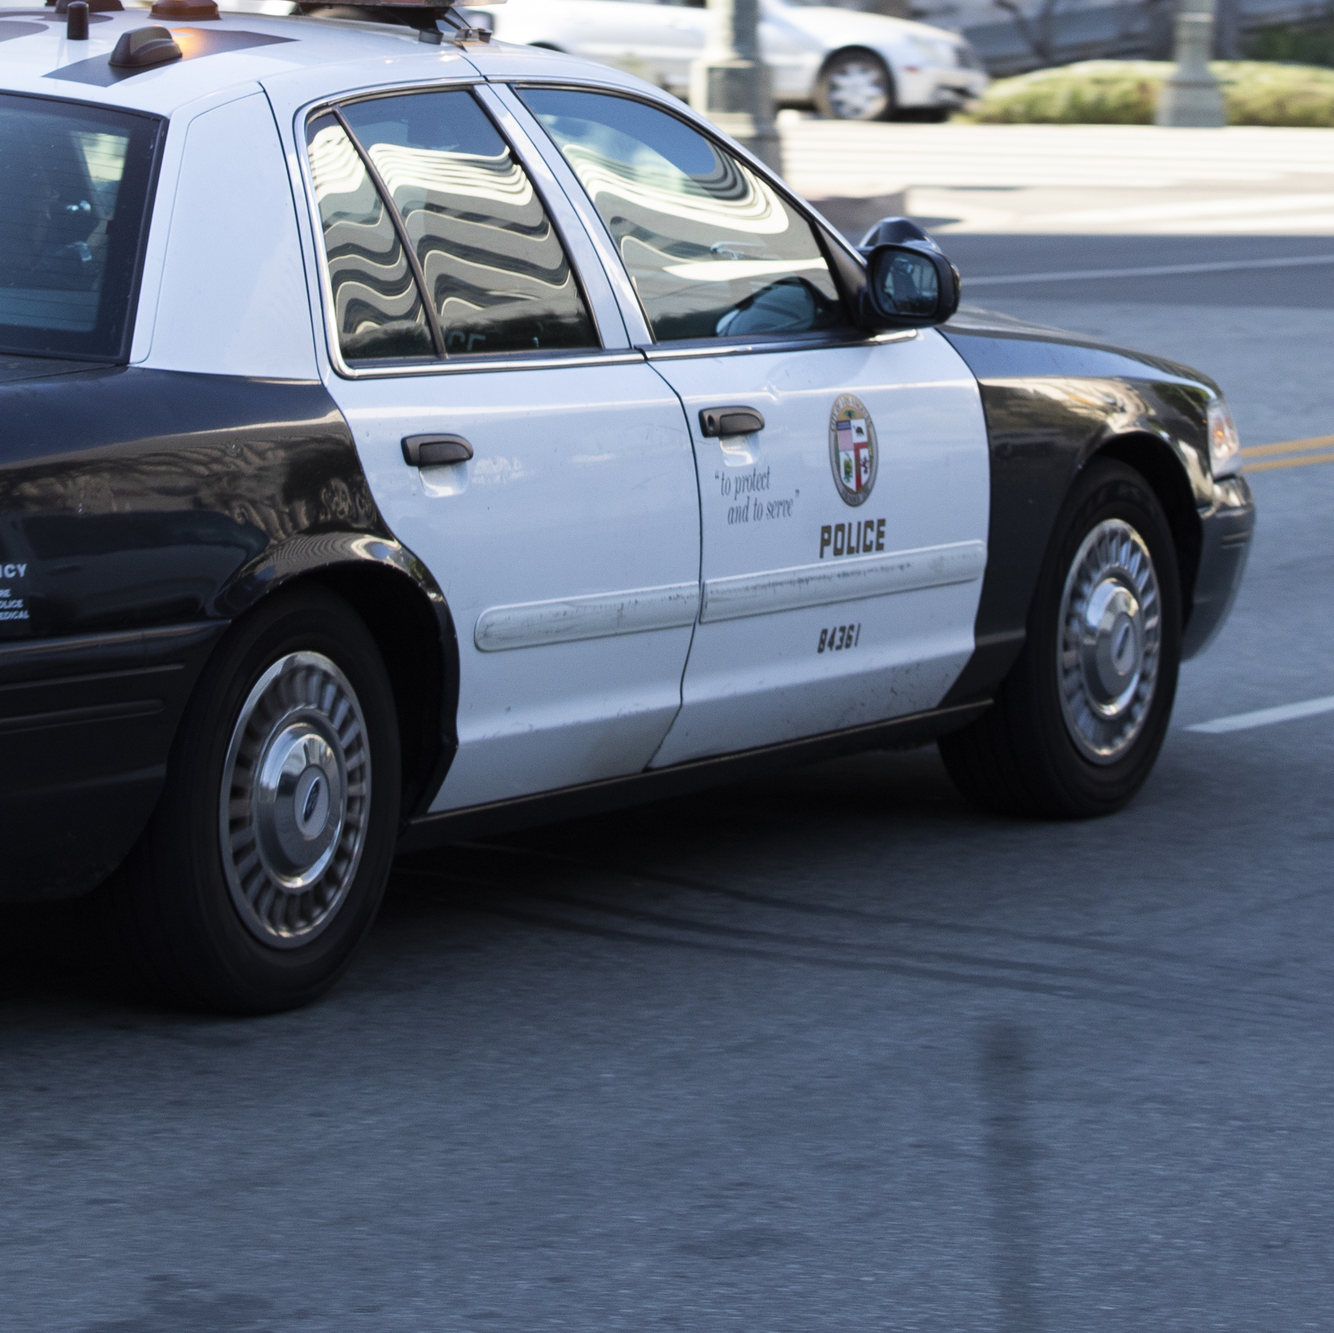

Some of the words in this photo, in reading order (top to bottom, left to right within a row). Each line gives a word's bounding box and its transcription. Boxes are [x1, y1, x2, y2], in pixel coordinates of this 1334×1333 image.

[733, 465, 770, 501] protect
[727, 496, 750, 526] and
[753, 497, 764, 522] to
[819, 518, 886, 559] POLICE
[817, 623, 861, 654] 84361
